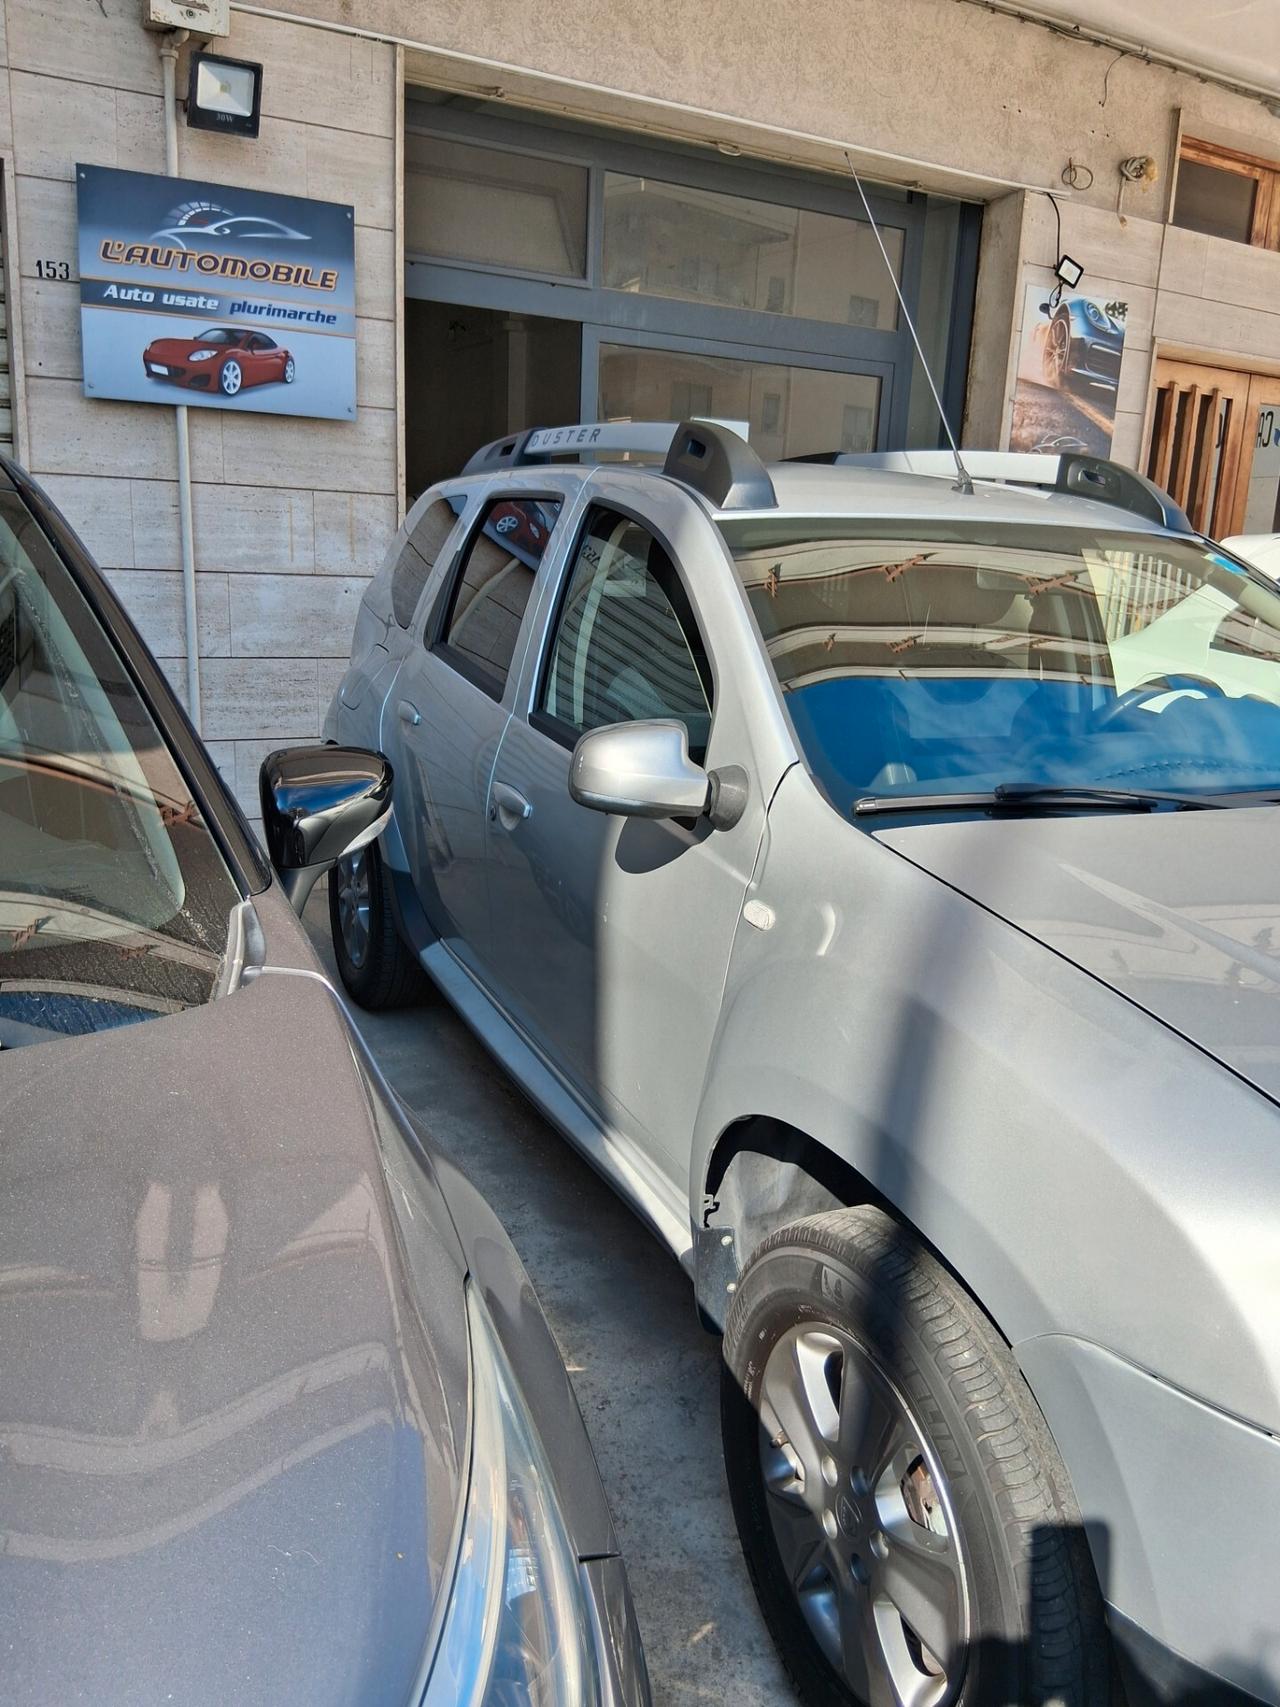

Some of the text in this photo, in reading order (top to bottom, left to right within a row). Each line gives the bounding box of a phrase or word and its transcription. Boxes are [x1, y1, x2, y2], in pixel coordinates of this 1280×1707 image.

[36, 259, 70, 280] 153
[101, 240, 338, 290] L'AUTOMOBILE
[104, 284, 337, 325] Auto usate plurimarche
[531, 428, 601, 447] DUSTER
